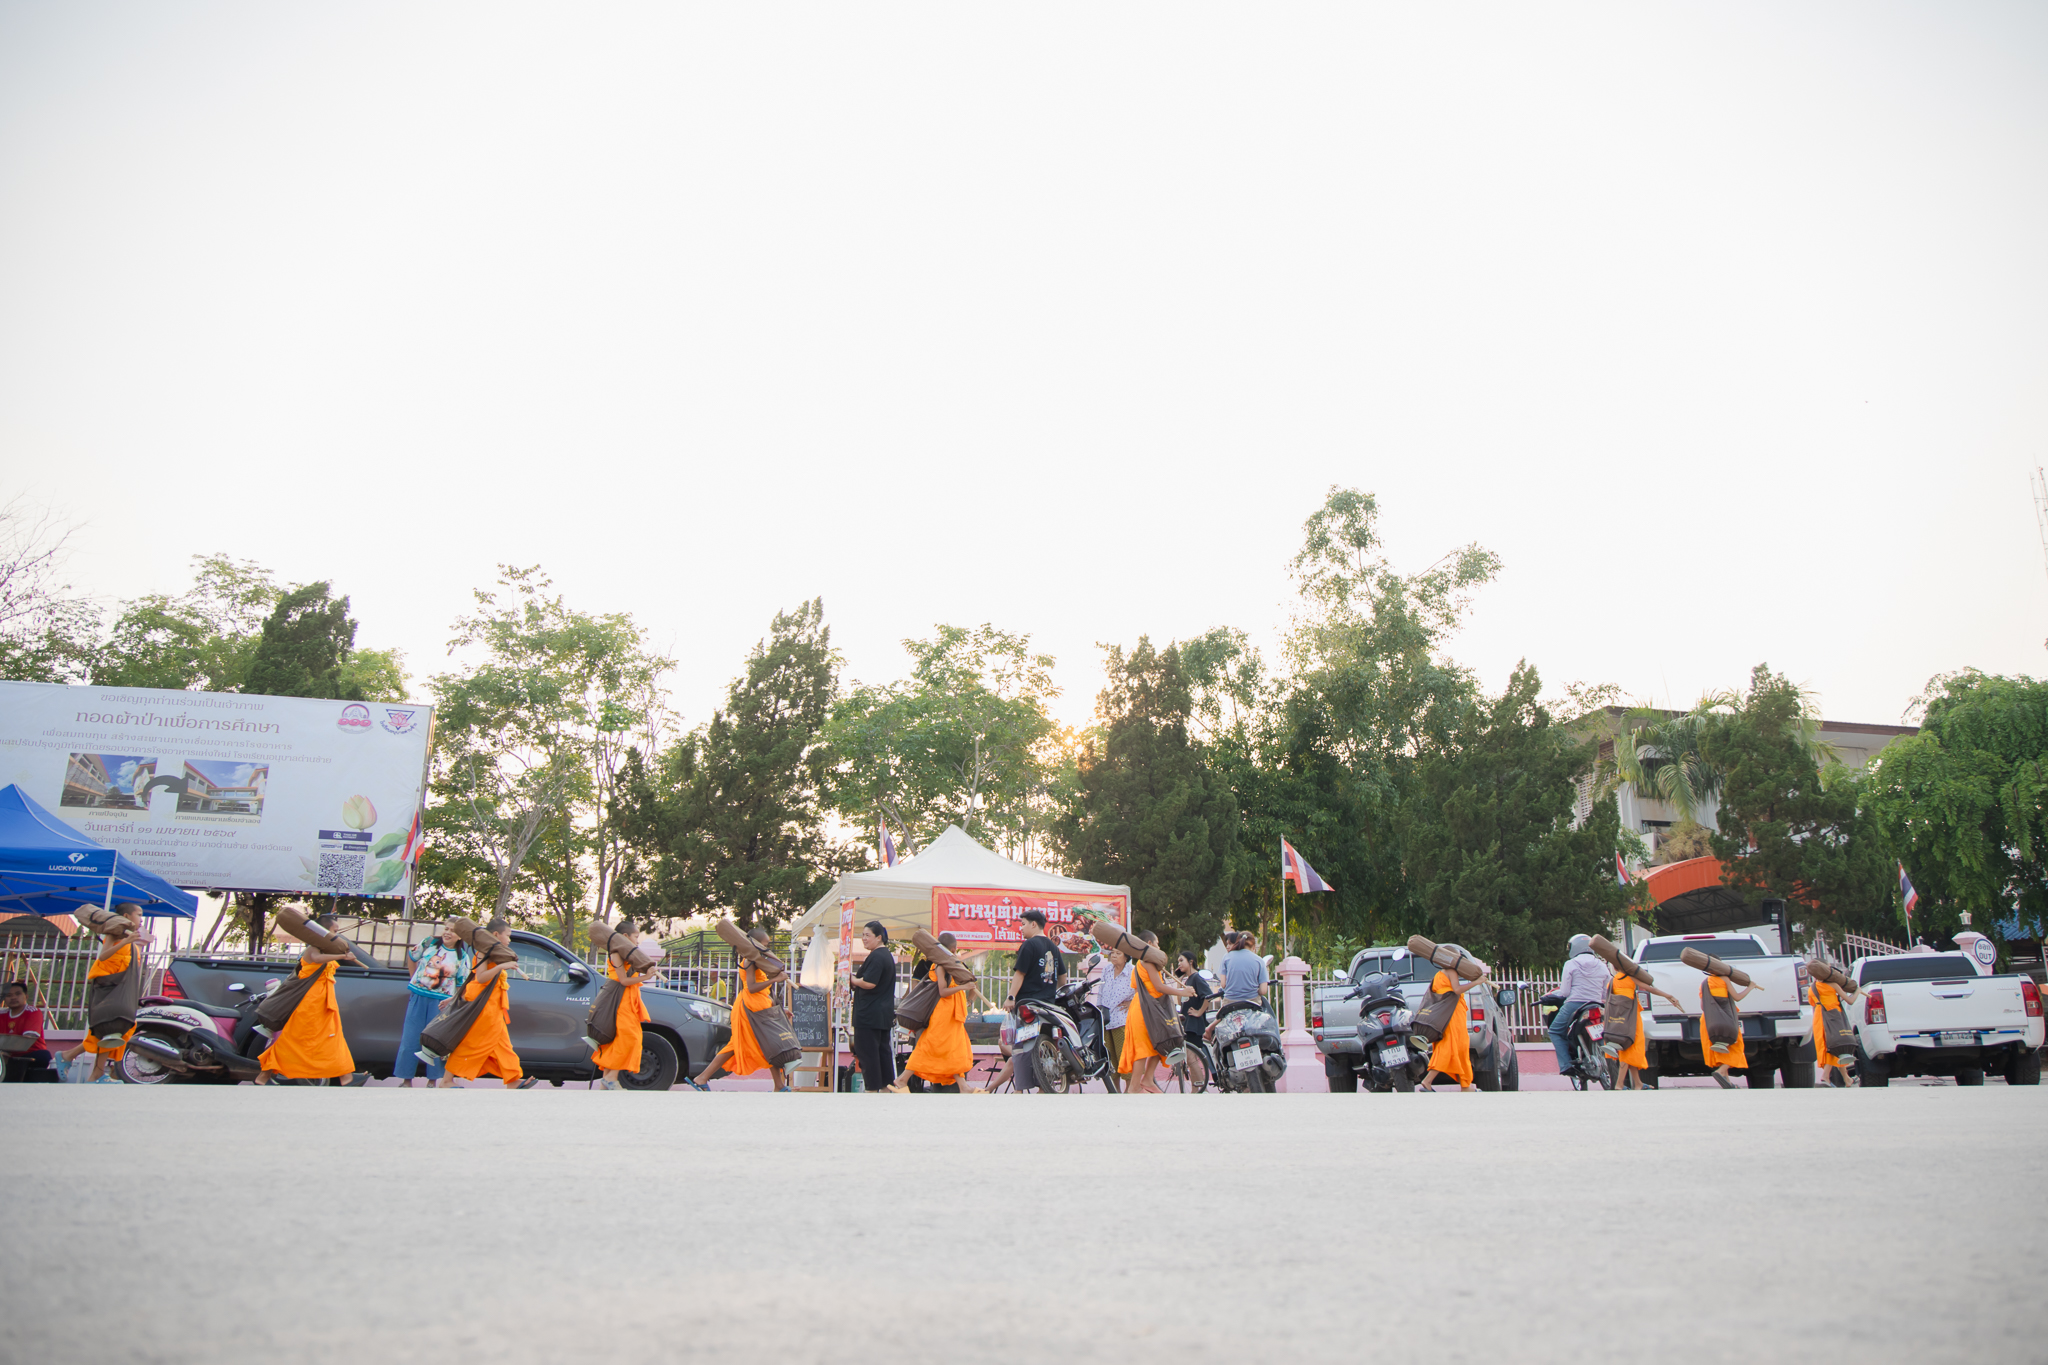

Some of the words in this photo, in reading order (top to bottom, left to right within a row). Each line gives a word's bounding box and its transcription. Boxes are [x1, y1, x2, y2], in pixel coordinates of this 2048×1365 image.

[100, 693, 264, 711] ขอเชิญทุกท่านร่วมเป็นเจ้าภาพ
[75, 710, 281, 734] ทอดผ้าป่าเพื่อการศึกษา
[155, 826, 200, 836] เมษายน
[48, 864, 98, 873] LUCKYFRIEND
[1979, 952, 1992, 960] OUT
